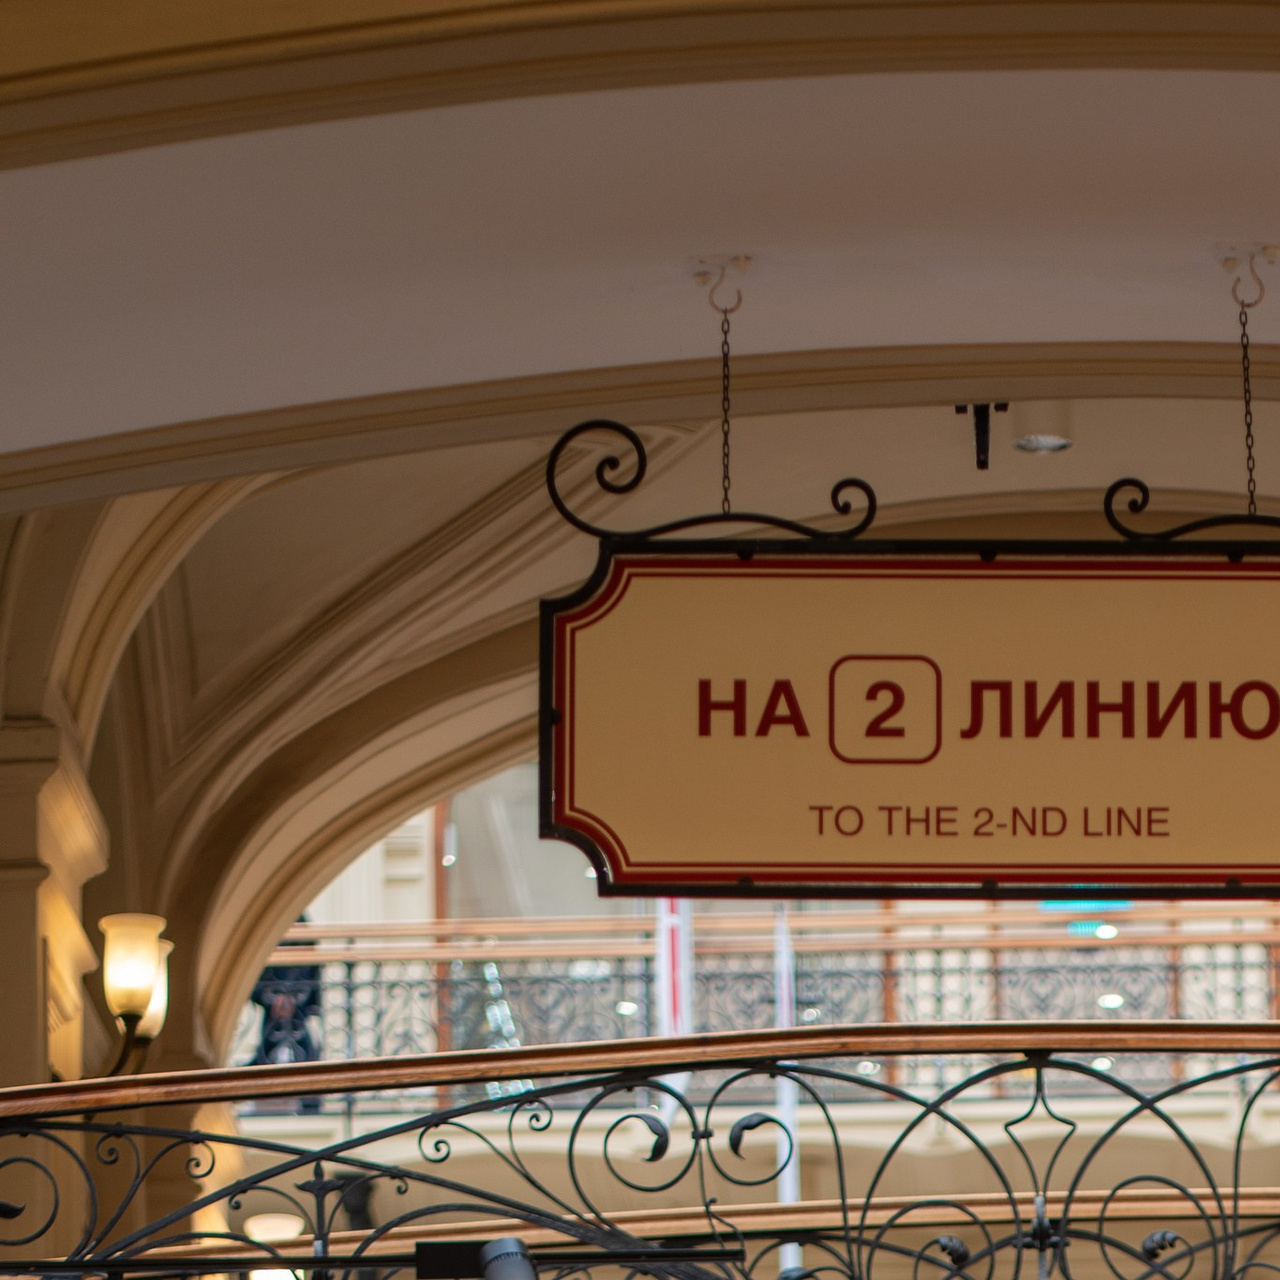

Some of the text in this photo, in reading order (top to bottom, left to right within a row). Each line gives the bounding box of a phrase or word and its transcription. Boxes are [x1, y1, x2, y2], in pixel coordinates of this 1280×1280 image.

[697, 678, 811, 739] НА
[864, 680, 907, 739] 2
[808, 805, 1171, 838] TO THE 2-ND LINE
